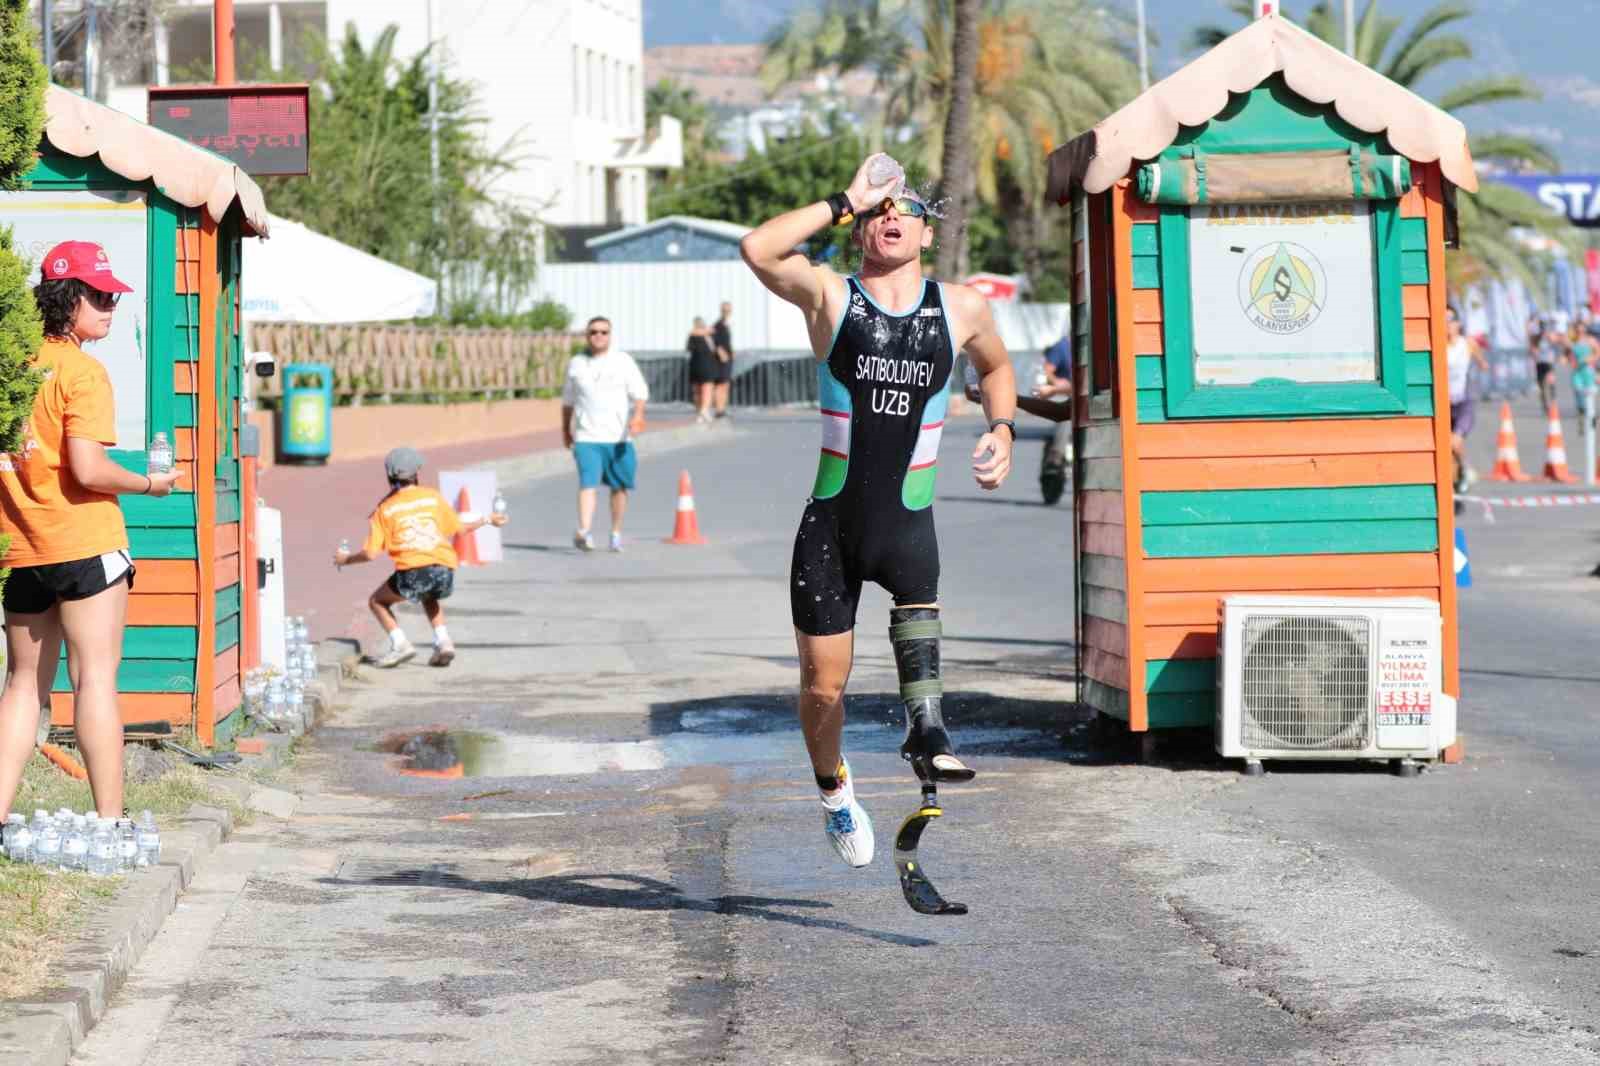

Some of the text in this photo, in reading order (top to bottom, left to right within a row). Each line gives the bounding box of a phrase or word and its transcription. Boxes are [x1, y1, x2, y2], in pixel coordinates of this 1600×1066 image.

[855, 354, 935, 387] SATIBOLDIYEV
[871, 388, 910, 416] UZB
[1379, 690, 1430, 705] ESSE
